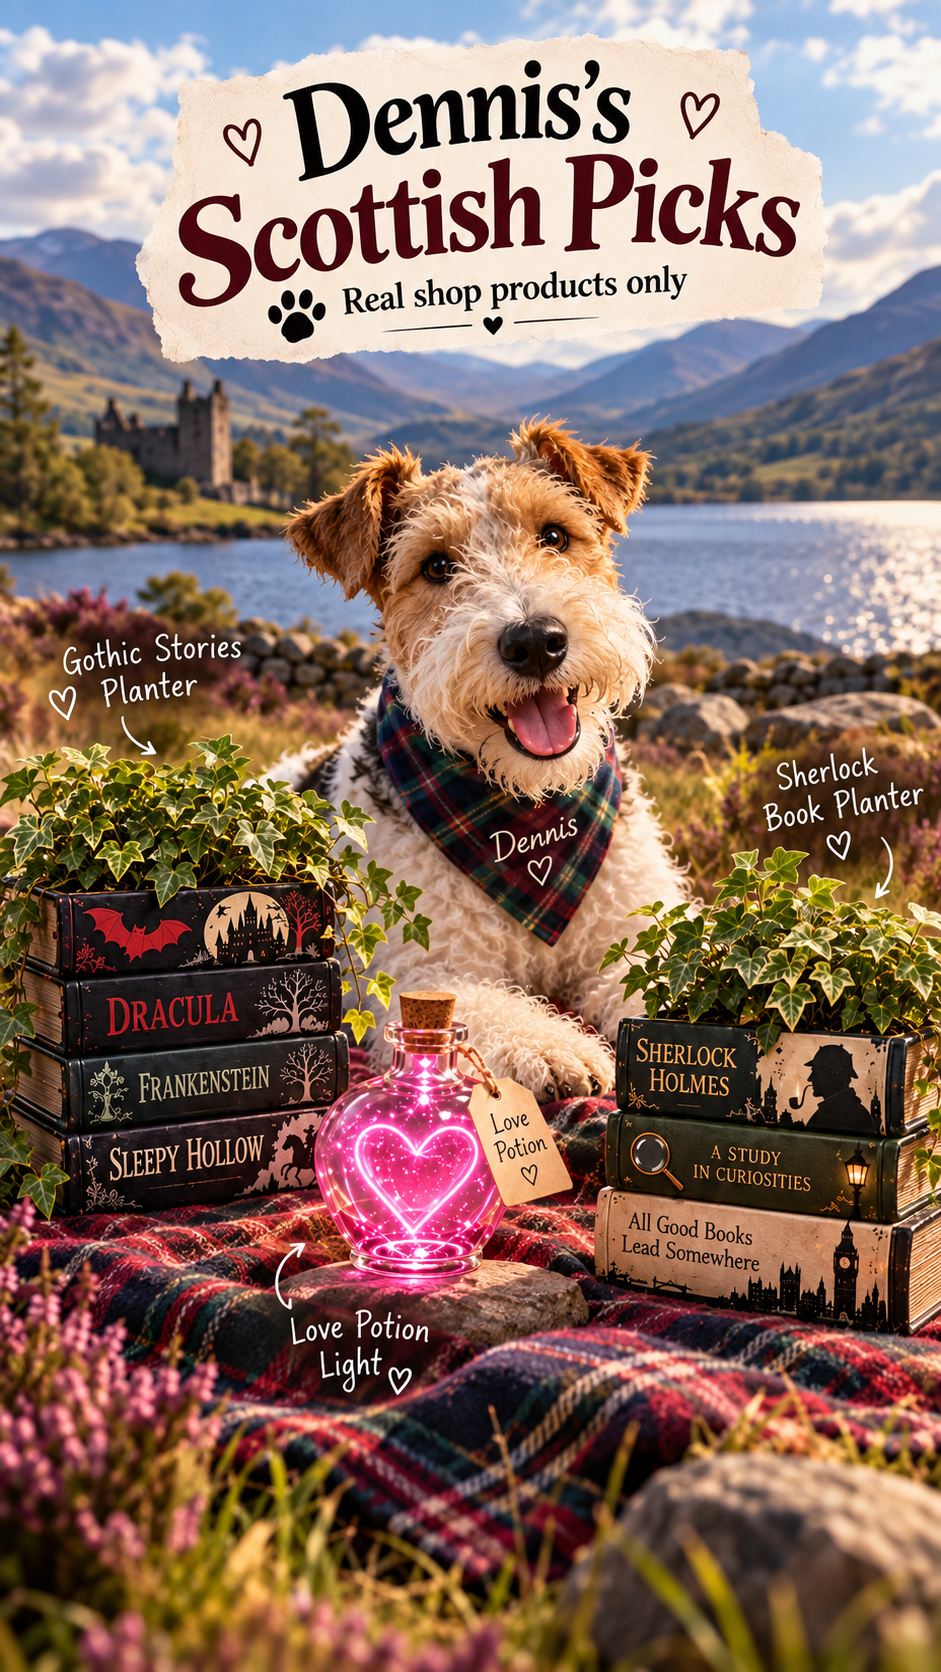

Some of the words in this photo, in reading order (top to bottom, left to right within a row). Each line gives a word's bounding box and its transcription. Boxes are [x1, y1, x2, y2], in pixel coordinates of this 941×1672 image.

[489, 816, 578, 863] Dennis
[106, 992, 239, 1037] DRACULA
[636, 1038, 737, 1069] SHERLOCK
[138, 1065, 270, 1103] FRANKENSTEIN
[649, 1068, 730, 1097] HOLMES
[490, 1111, 530, 1135] Love
[109, 1145, 179, 1182] SLEEPY
[186, 1134, 265, 1172] HOLLOW
[493, 1137, 548, 1163] Potion
[711, 1145, 721, 1160] A
[728, 1147, 781, 1166] STUDY
[693, 1164, 710, 1179] IN
[716, 1167, 812, 1192] CURIOSITIES
[628, 1212, 651, 1232] All
[656, 1215, 699, 1239] Good
[704, 1222, 753, 1246] Books
[621, 1234, 661, 1257] Lead
[665, 1242, 760, 1272] Somewhere
